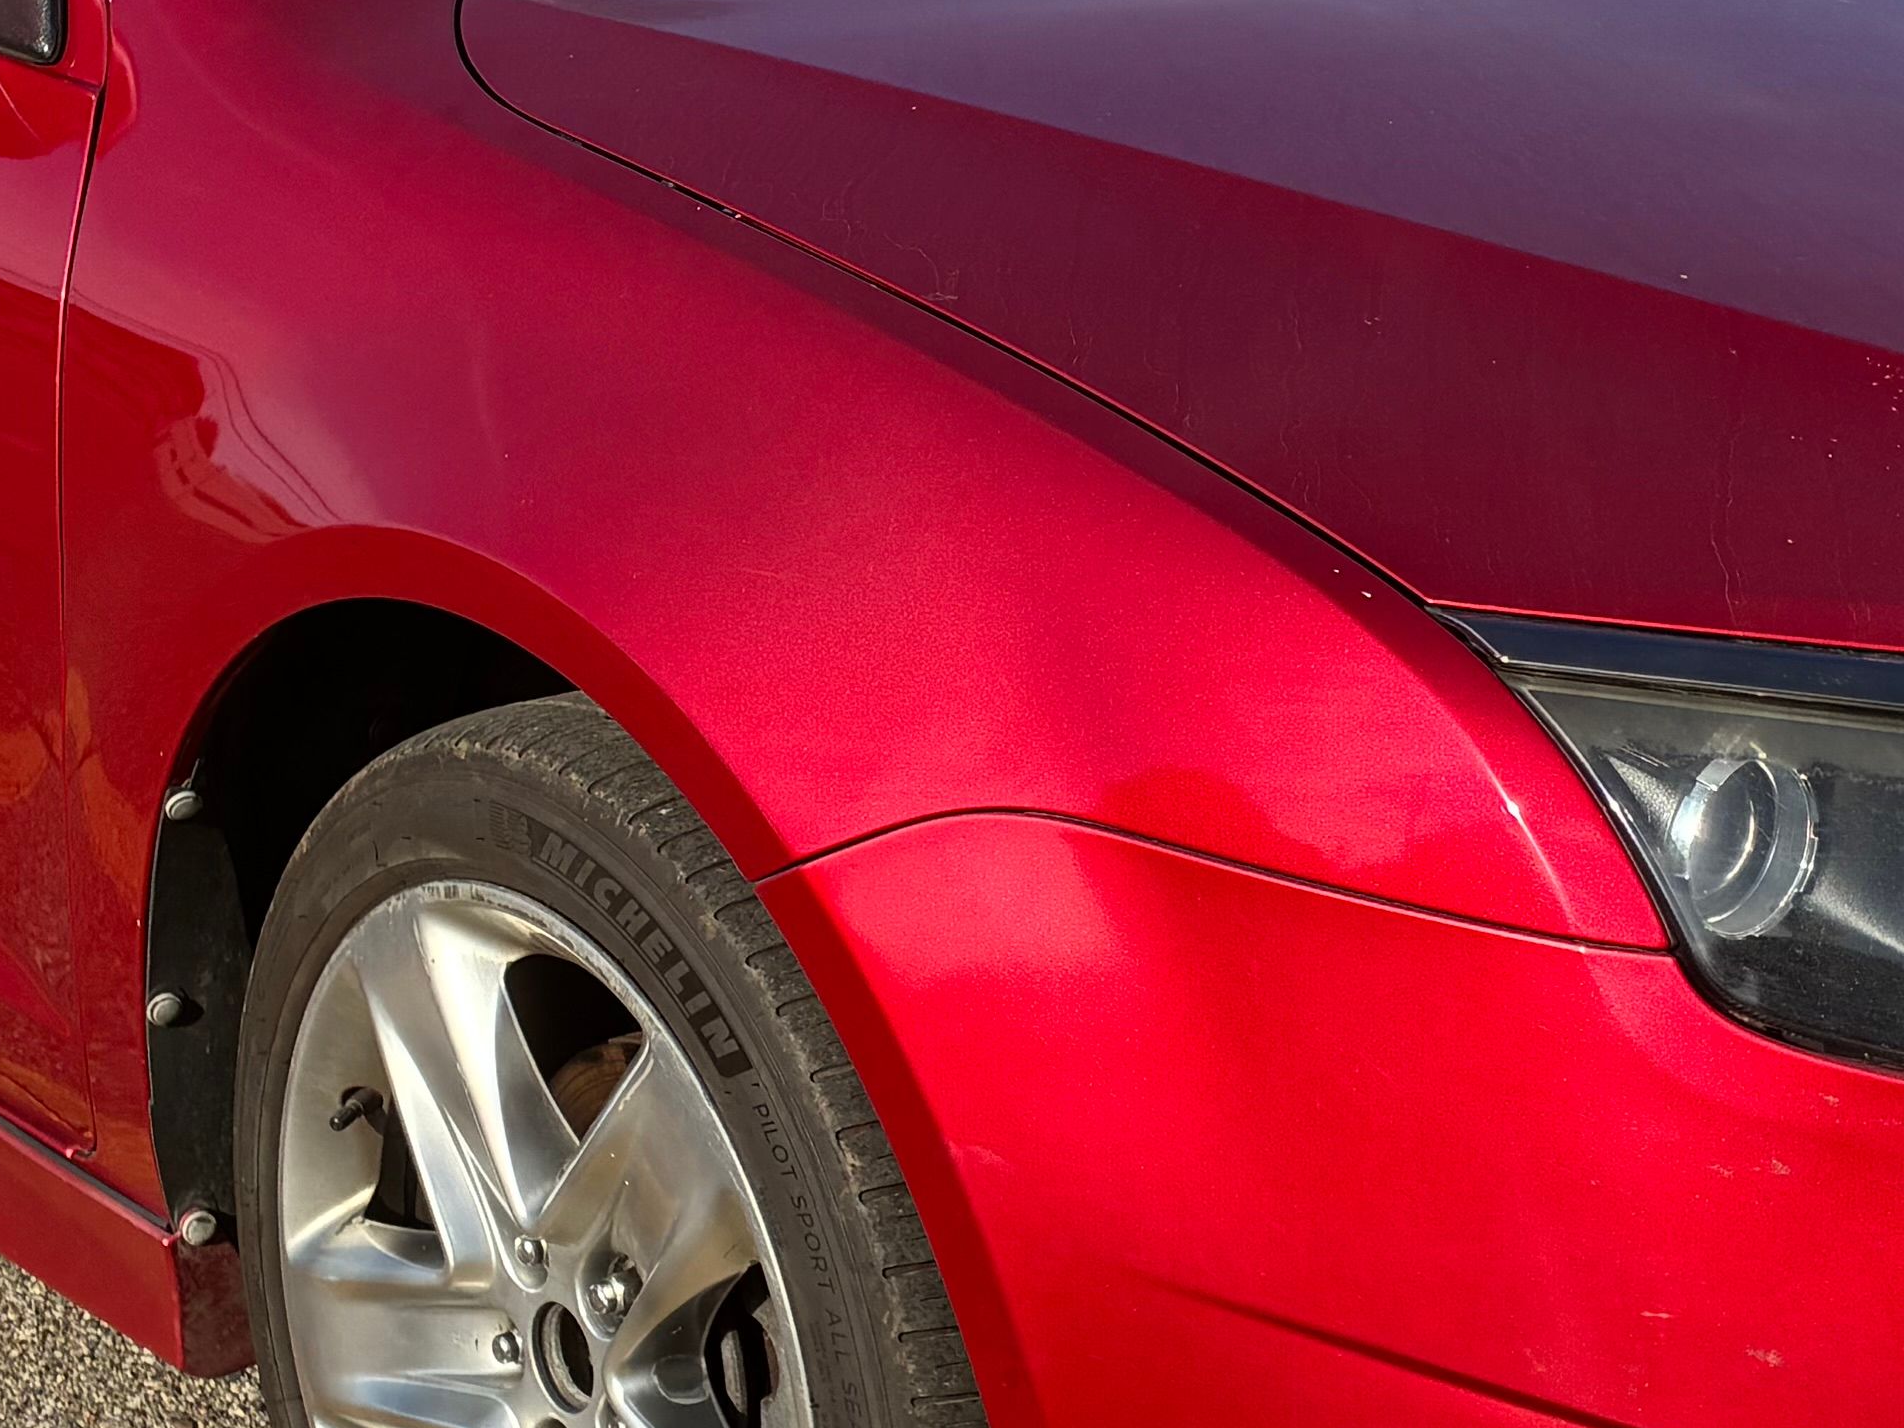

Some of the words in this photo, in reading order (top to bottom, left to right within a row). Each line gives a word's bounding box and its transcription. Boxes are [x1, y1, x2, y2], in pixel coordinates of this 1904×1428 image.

[539, 832, 741, 1060] MICHELIN
[752, 1102, 798, 1181] PILOT
[790, 1194, 836, 1295] SPORT
[827, 1308, 850, 1365] ALL
